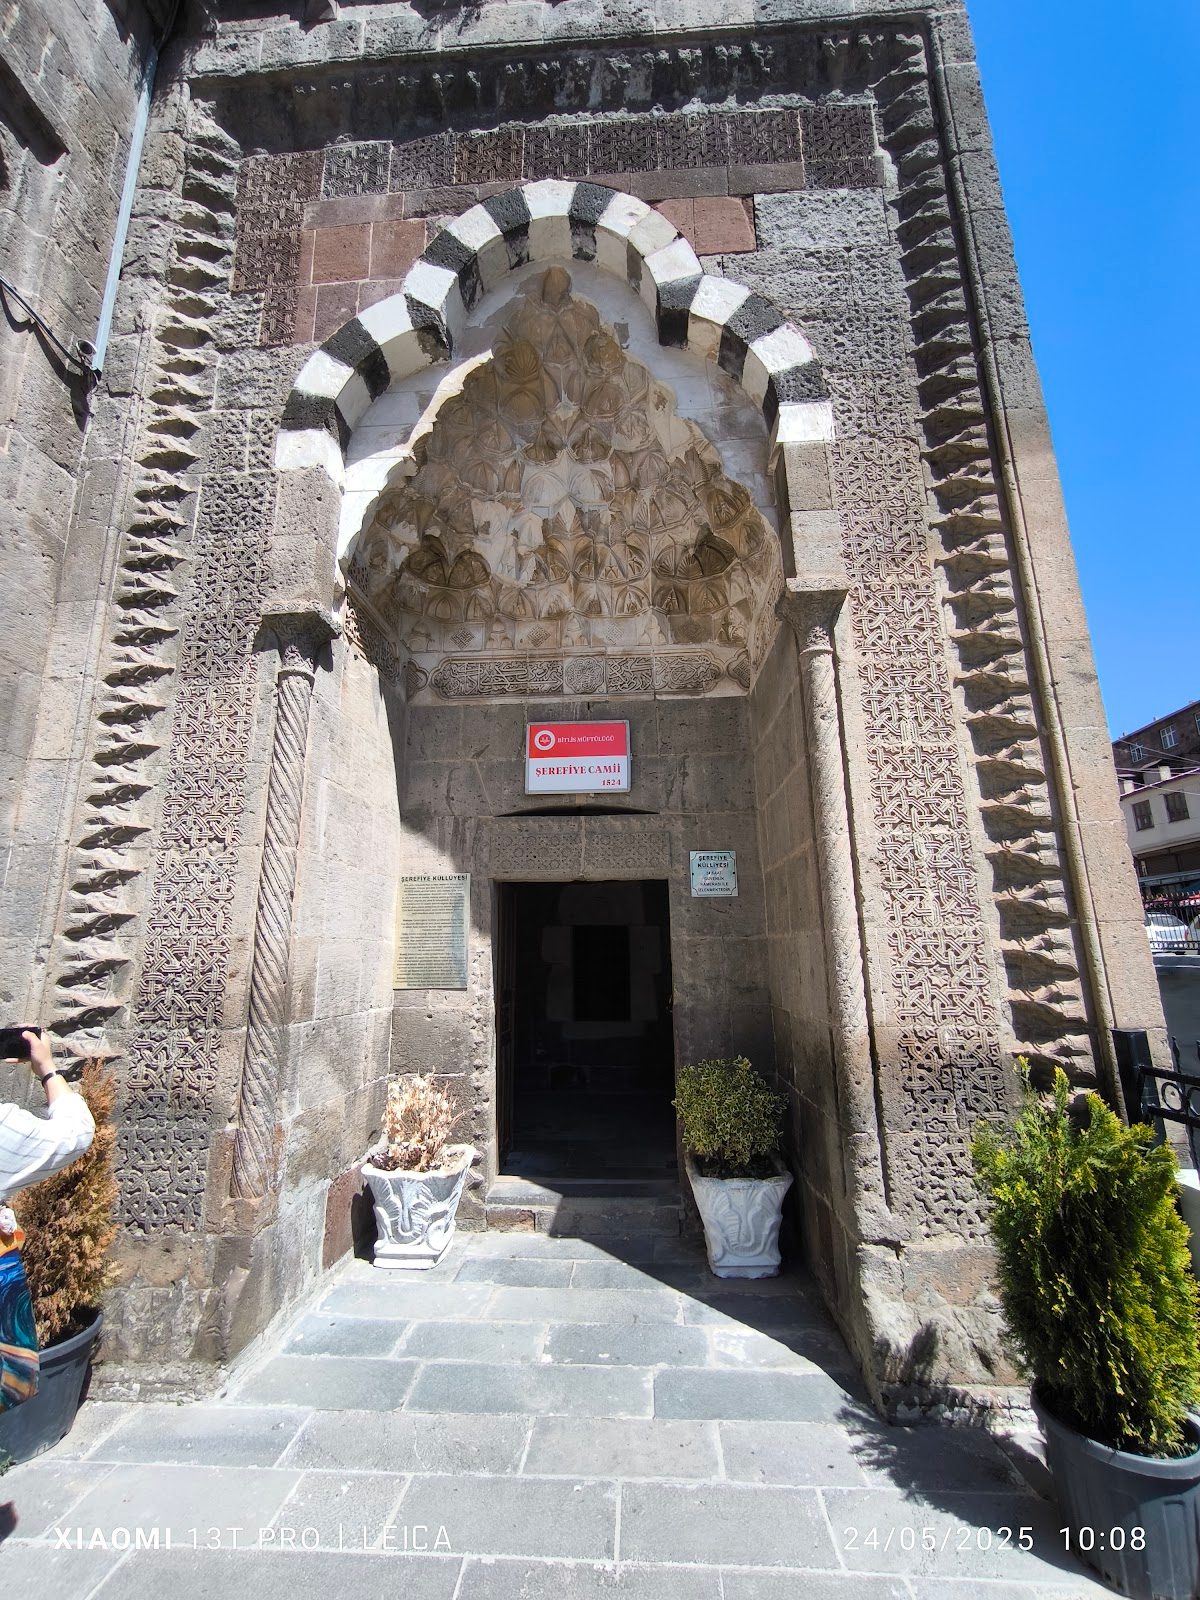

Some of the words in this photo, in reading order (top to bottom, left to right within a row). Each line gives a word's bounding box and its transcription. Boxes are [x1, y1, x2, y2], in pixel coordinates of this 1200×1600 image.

[535, 764, 587, 777] ŞEREFİYE
[588, 763, 621, 774] CAMİİ
[401, 875, 431, 883] ŞEREFİYE
